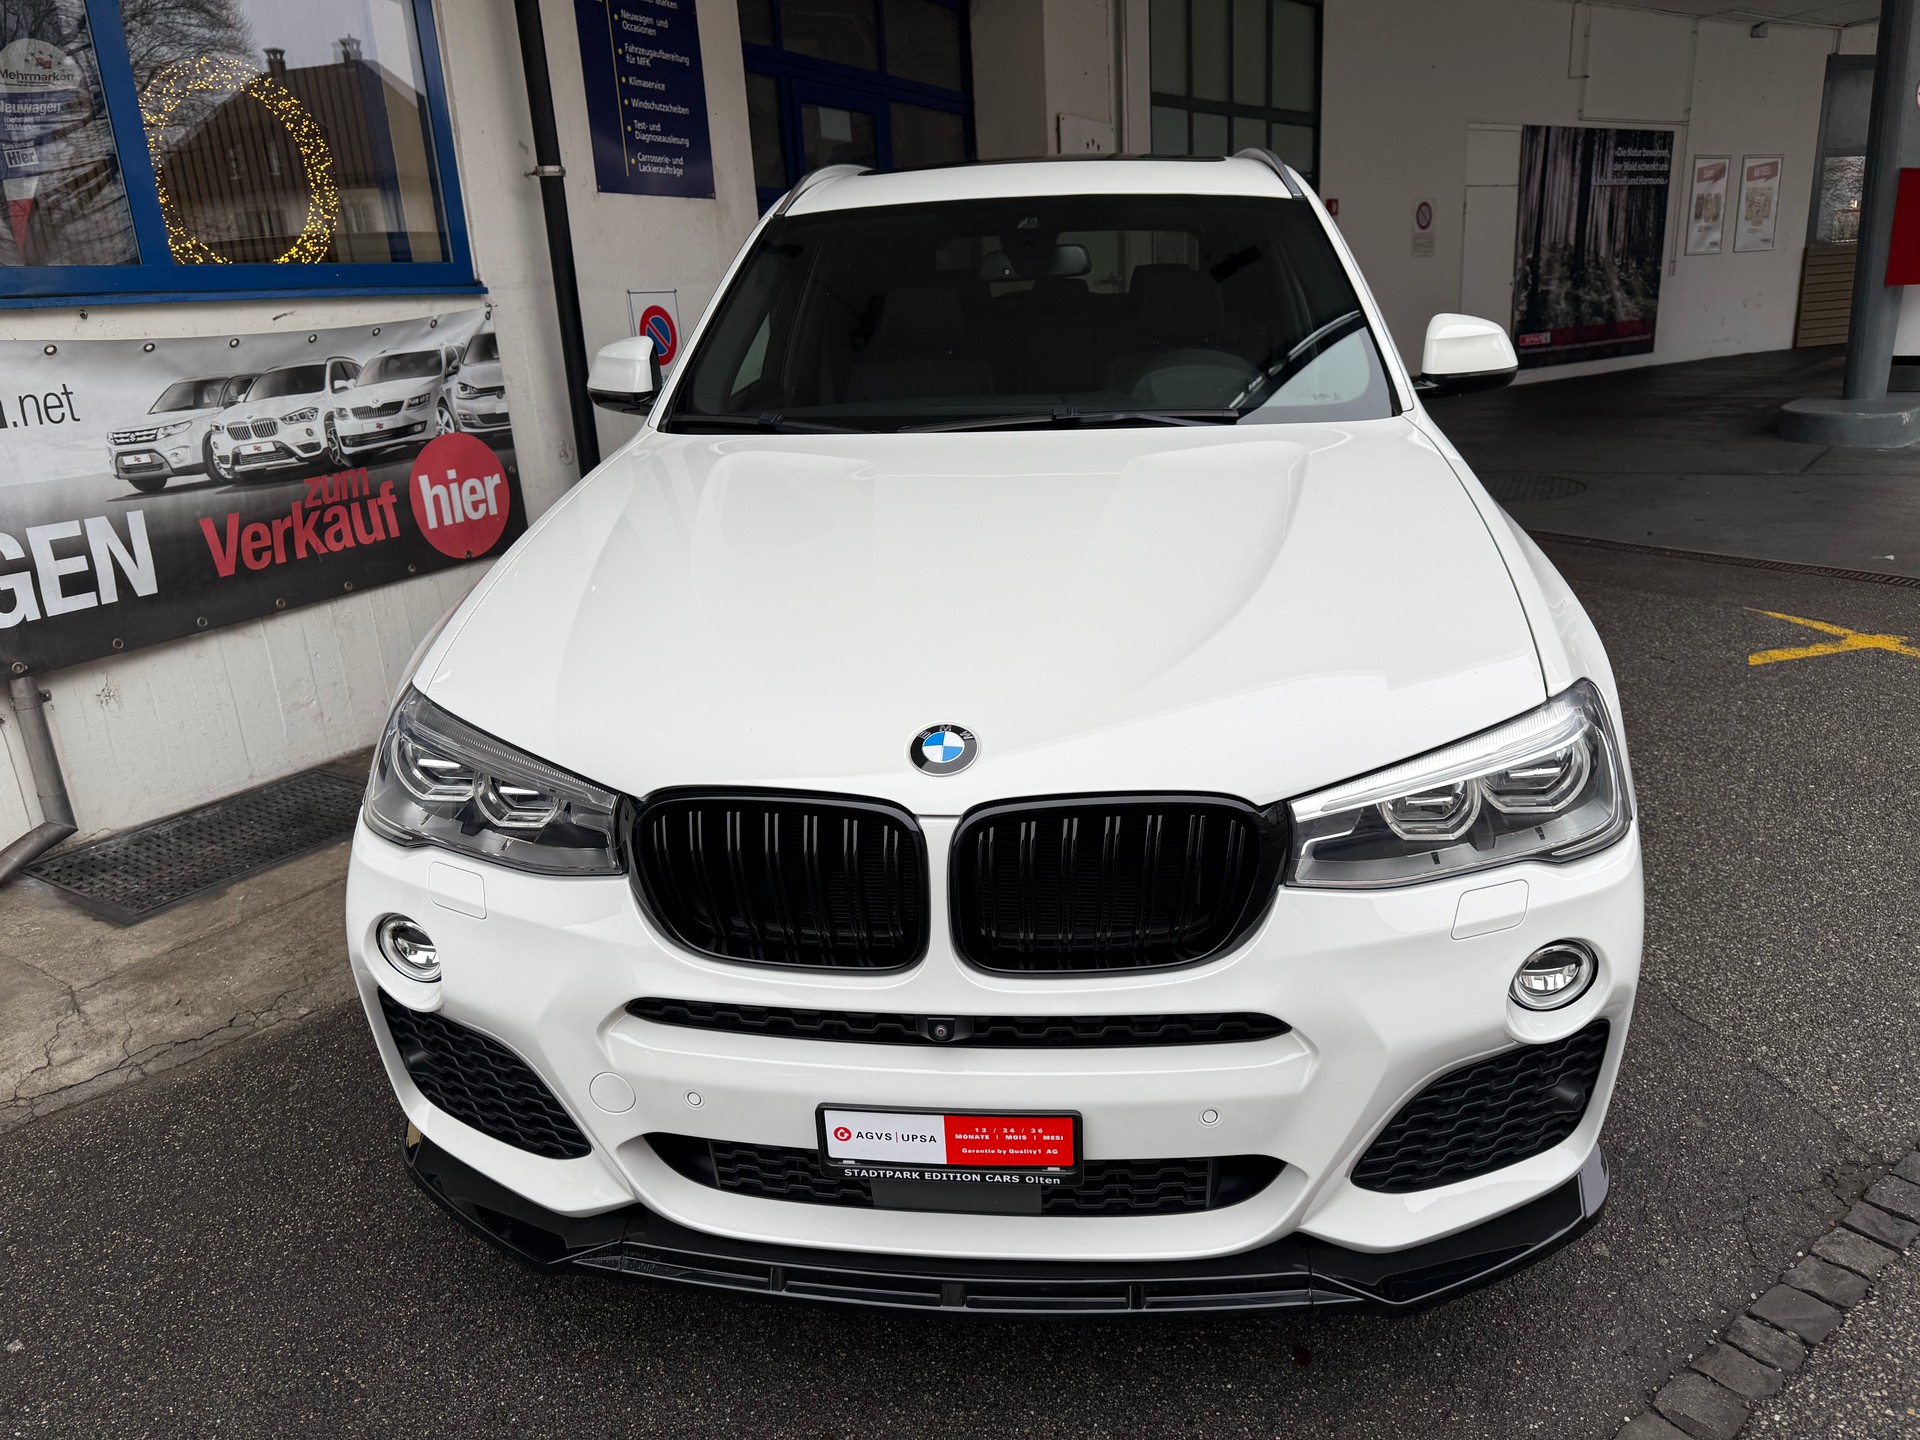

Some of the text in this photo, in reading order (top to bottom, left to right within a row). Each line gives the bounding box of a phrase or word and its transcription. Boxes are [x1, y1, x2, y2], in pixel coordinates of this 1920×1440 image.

[621, 9, 668, 28] Neuwagen und
[622, 21, 657, 36] Occasionen
[624, 43, 690, 66] Fahrzeugaufbereitung
[626, 53, 651, 67] für MFK
[628, 76, 666, 91] Klimaservice
[631, 98, 690, 115] Windschutzscheiben
[634, 120, 661, 131] Test- und
[635, 131, 690, 147] Diagnoseauslesung
[6, 151, 37, 166] Hier
[637, 152, 683, 165] Carrosserie- und
[638, 163, 684, 177] Lackieraufträge
[303, 466, 370, 508] zum
[198, 469, 501, 578] Verkauf hier
[918, 724, 975, 740] BMW
[856, 1131, 937, 1143] AGVS UPSA
[844, 1168, 1060, 1184] STADTPARK EDITION CARS Olten
